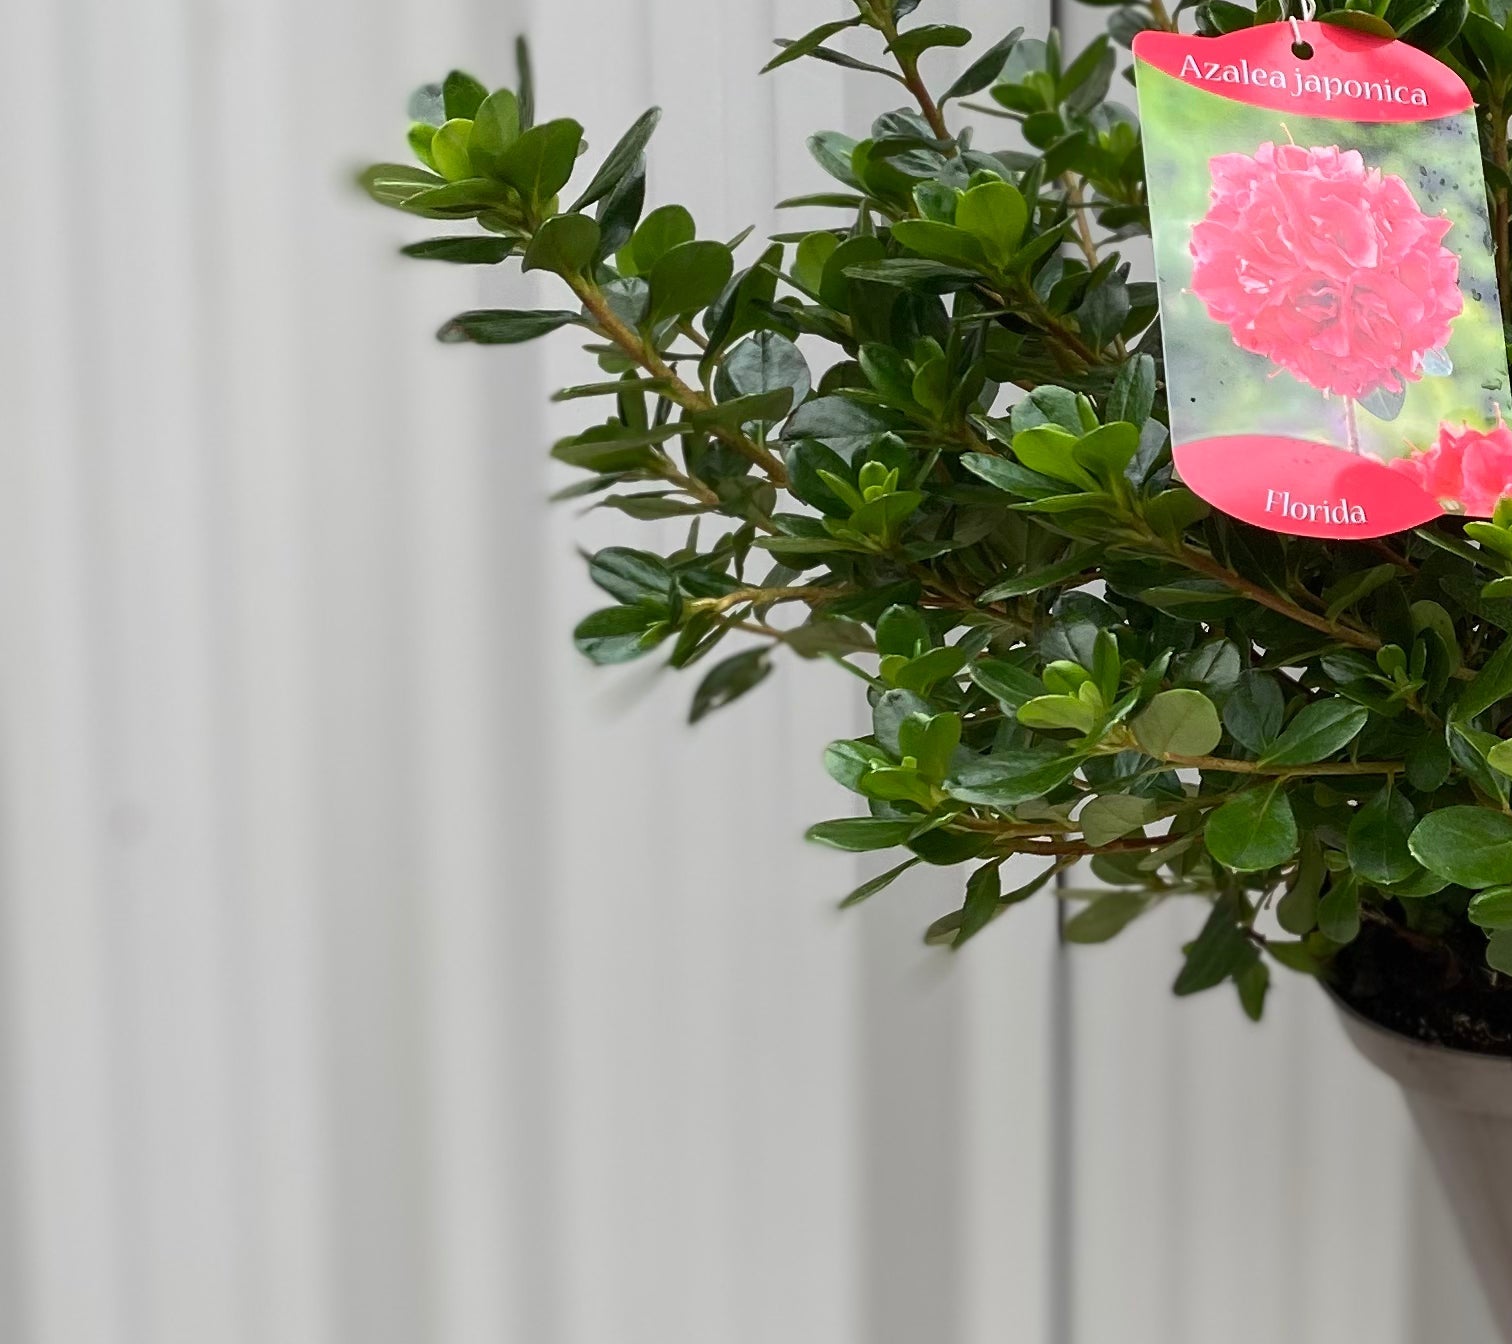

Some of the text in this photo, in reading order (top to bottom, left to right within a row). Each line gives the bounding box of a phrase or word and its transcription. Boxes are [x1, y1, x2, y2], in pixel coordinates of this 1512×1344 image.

[1179, 54, 1429, 106] Azalea japonica
[1264, 488, 1368, 524] Florida
